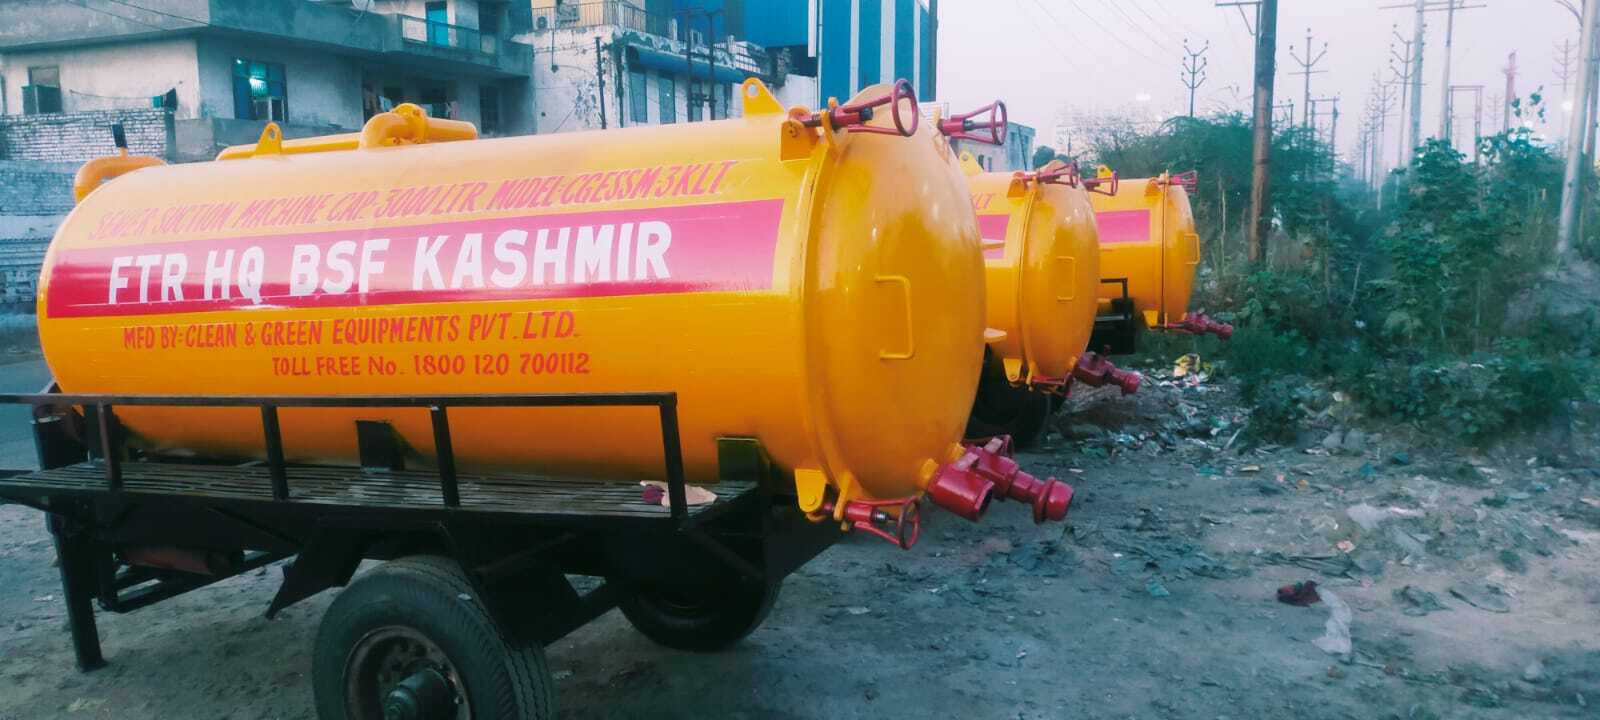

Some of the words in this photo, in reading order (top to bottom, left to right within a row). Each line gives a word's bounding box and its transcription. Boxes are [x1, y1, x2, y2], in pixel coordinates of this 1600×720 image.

[152, 201, 240, 234] SUCTION
[232, 193, 334, 228] MACHINE
[109, 253, 189, 304] FTR
[203, 246, 266, 305] HQ
[289, 238, 391, 297] BSF
[412, 221, 673, 291] KASHMIR
[123, 325, 155, 349] MFD
[244, 321, 256, 347] &
[261, 319, 323, 346] GREEN
[332, 314, 460, 345] EQUIPMENTS
[272, 356, 311, 376] TOLL
[316, 355, 361, 377] FREE
[413, 354, 466, 376] 1800
[474, 353, 510, 375] 120
[519, 352, 590, 375] 700112
